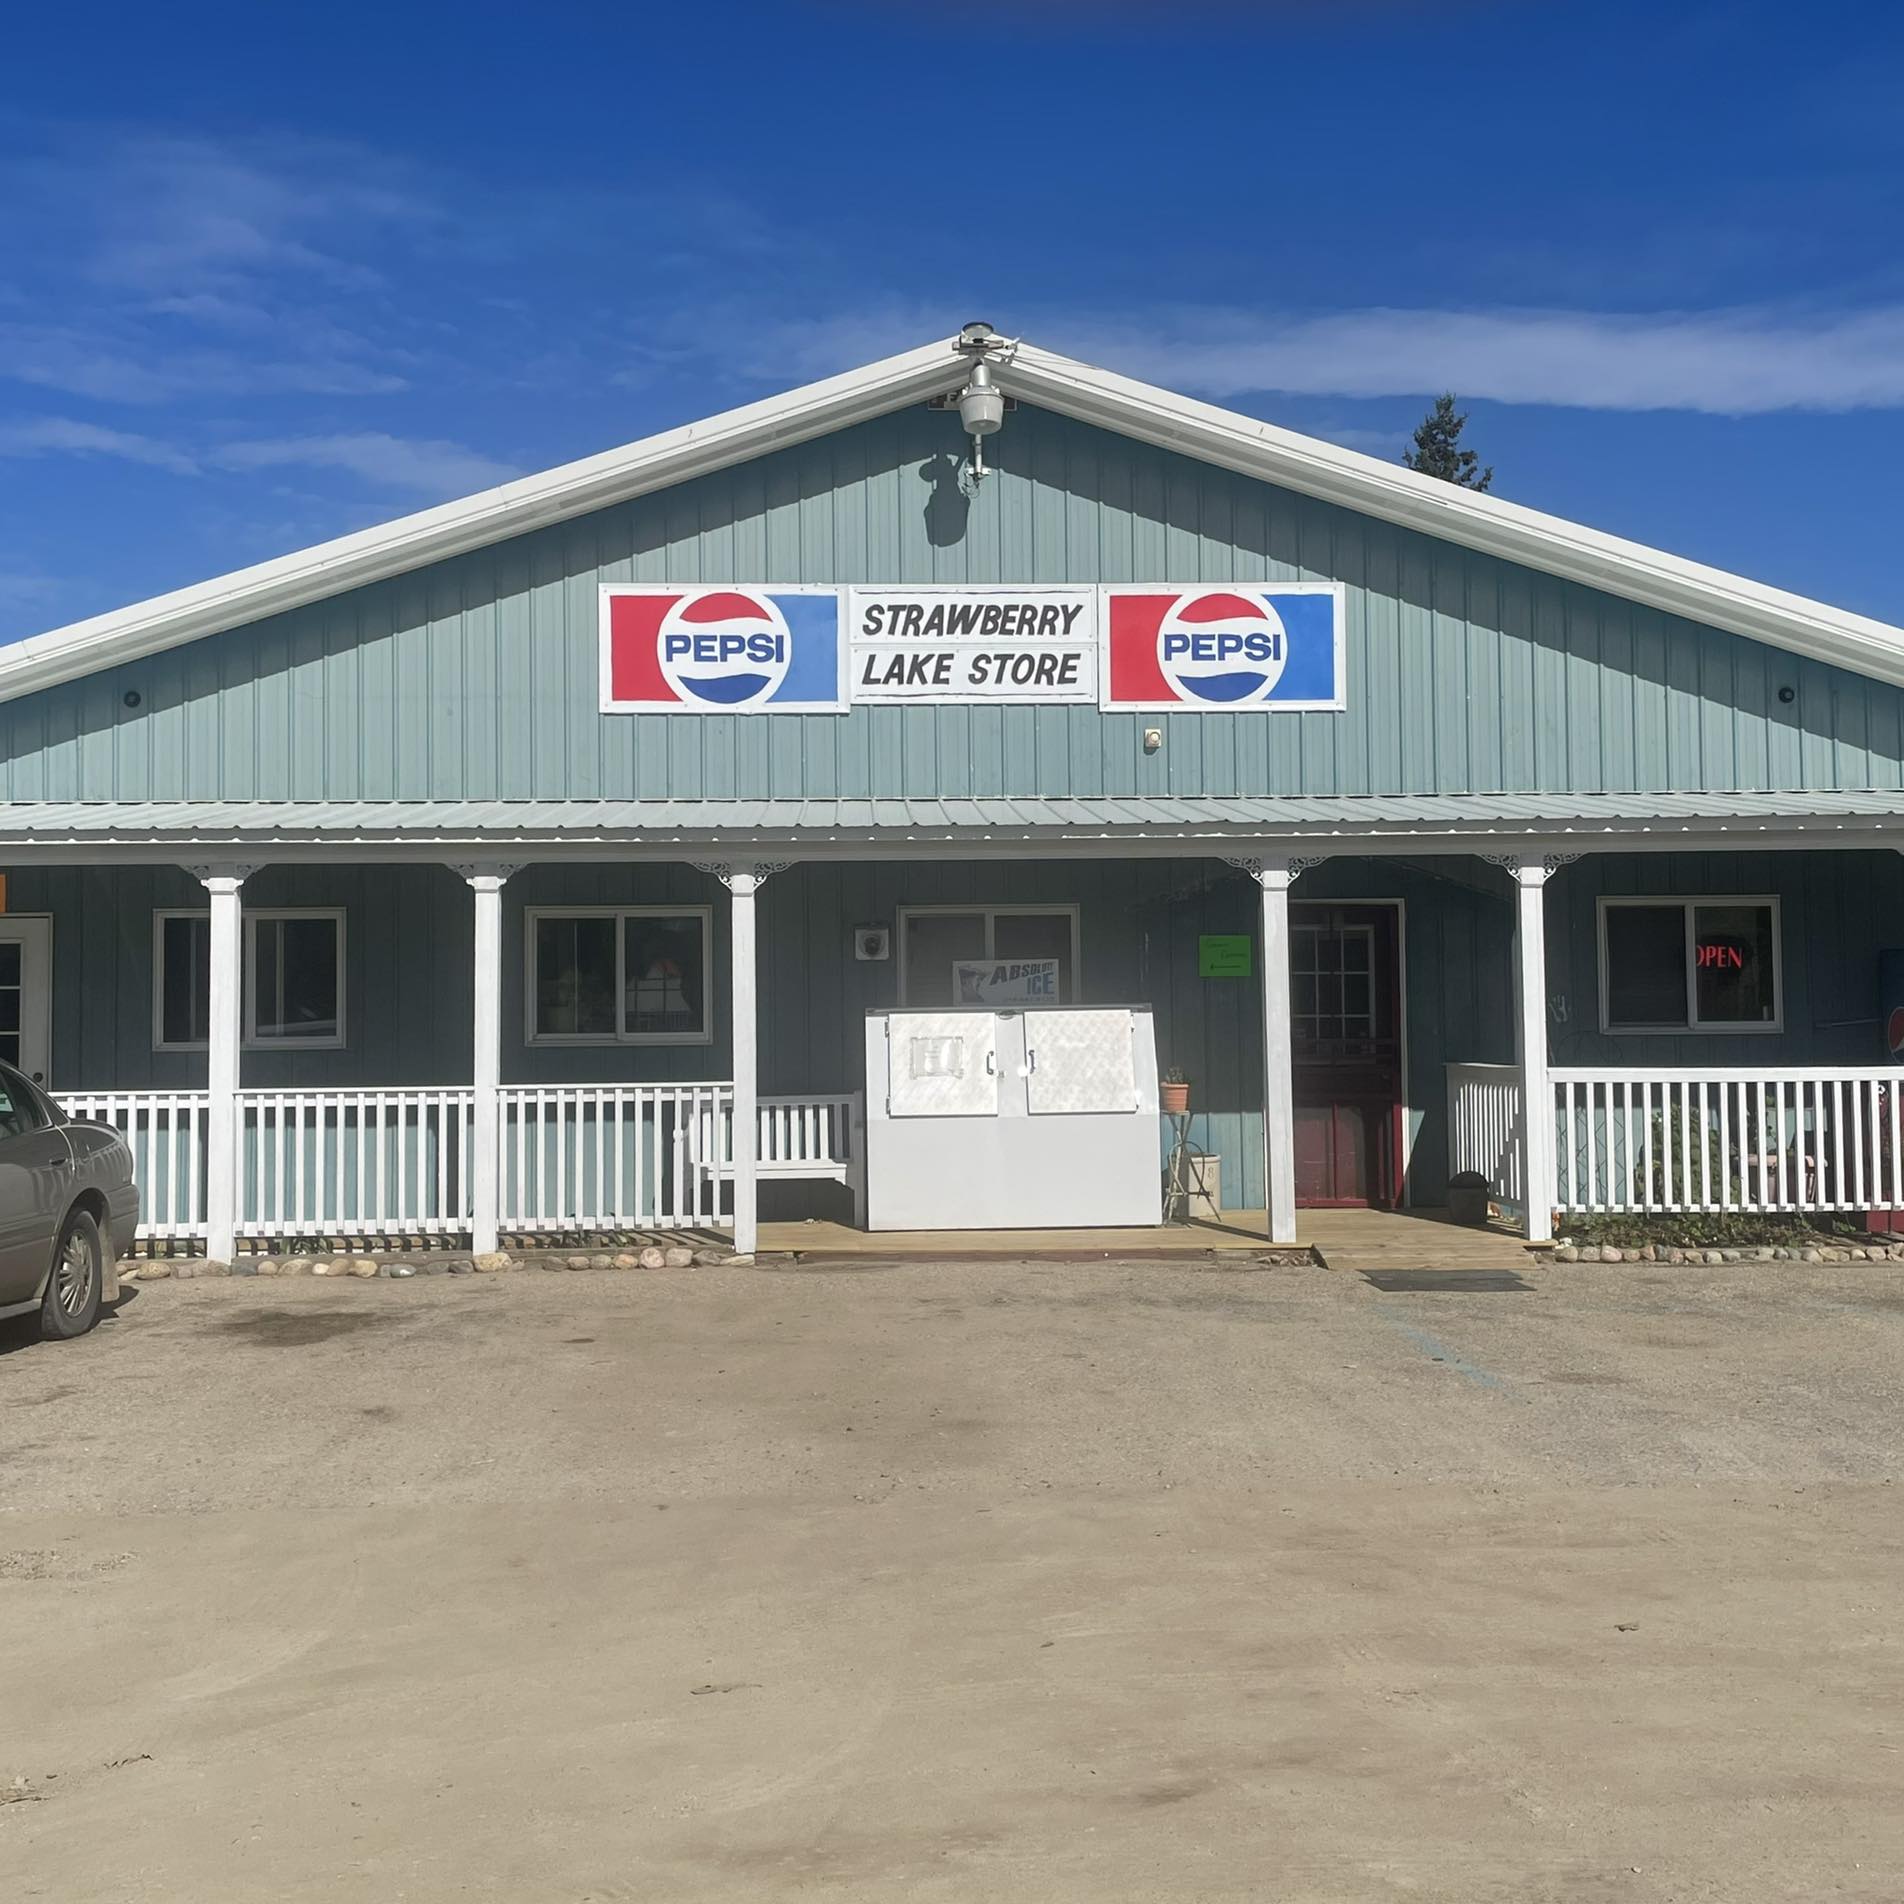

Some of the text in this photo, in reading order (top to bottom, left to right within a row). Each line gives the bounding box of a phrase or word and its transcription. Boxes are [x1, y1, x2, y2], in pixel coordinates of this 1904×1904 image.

[861, 603, 1084, 637] STRAWBERRY
[664, 633, 785, 664] PEPSI
[1163, 632, 1281, 662] PEPSI
[861, 653, 1082, 686] LAKE STORE
[1026, 972, 1055, 996] ICE
